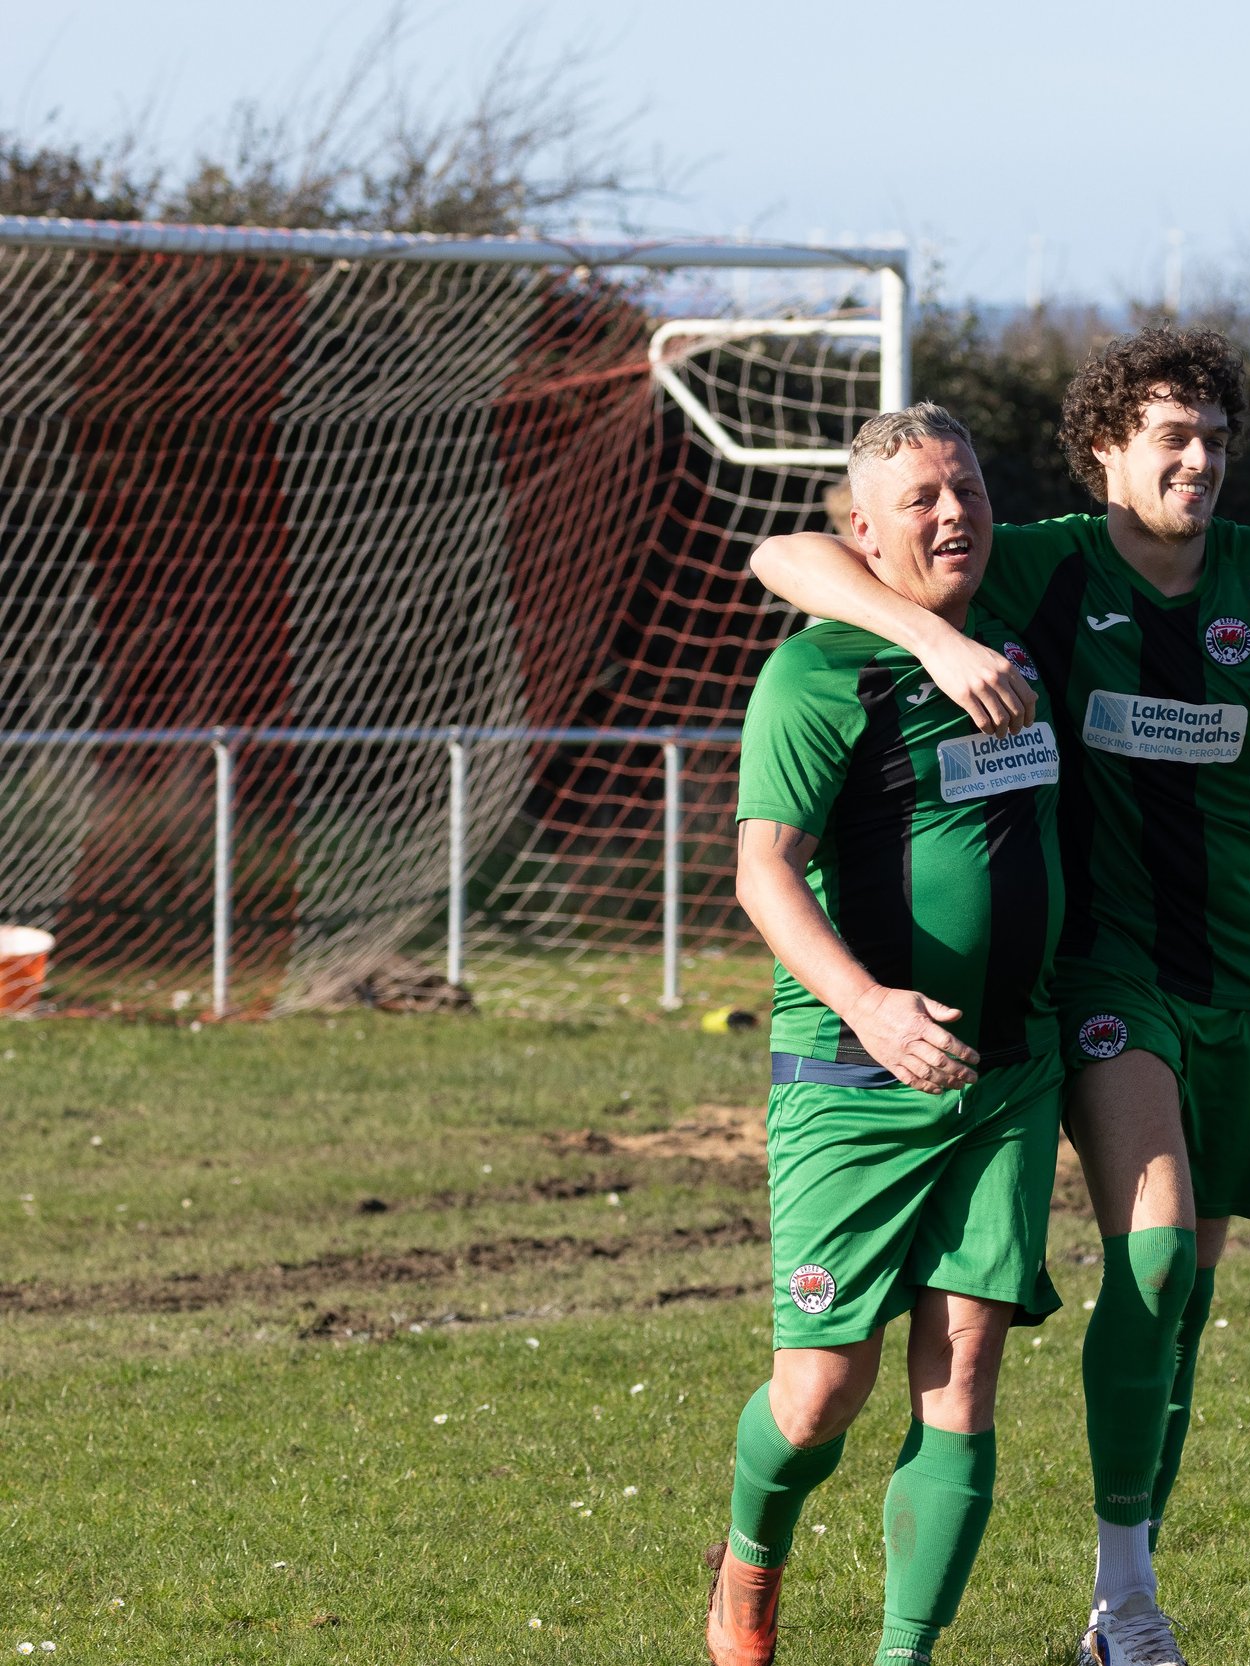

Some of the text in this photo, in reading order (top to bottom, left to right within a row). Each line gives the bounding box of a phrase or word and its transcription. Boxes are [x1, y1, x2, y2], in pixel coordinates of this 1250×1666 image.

[1132, 701, 1223, 726] Lakeland
[971, 728, 1044, 757] Lakeland
[1131, 720, 1240, 743] Verandahs
[1087, 733, 1238, 757] DECKING FENCING PERGOLAS
[975, 746, 1058, 775] Verandahs
[945, 782, 986, 798] DECKING
[990, 773, 1027, 788] FENCING
